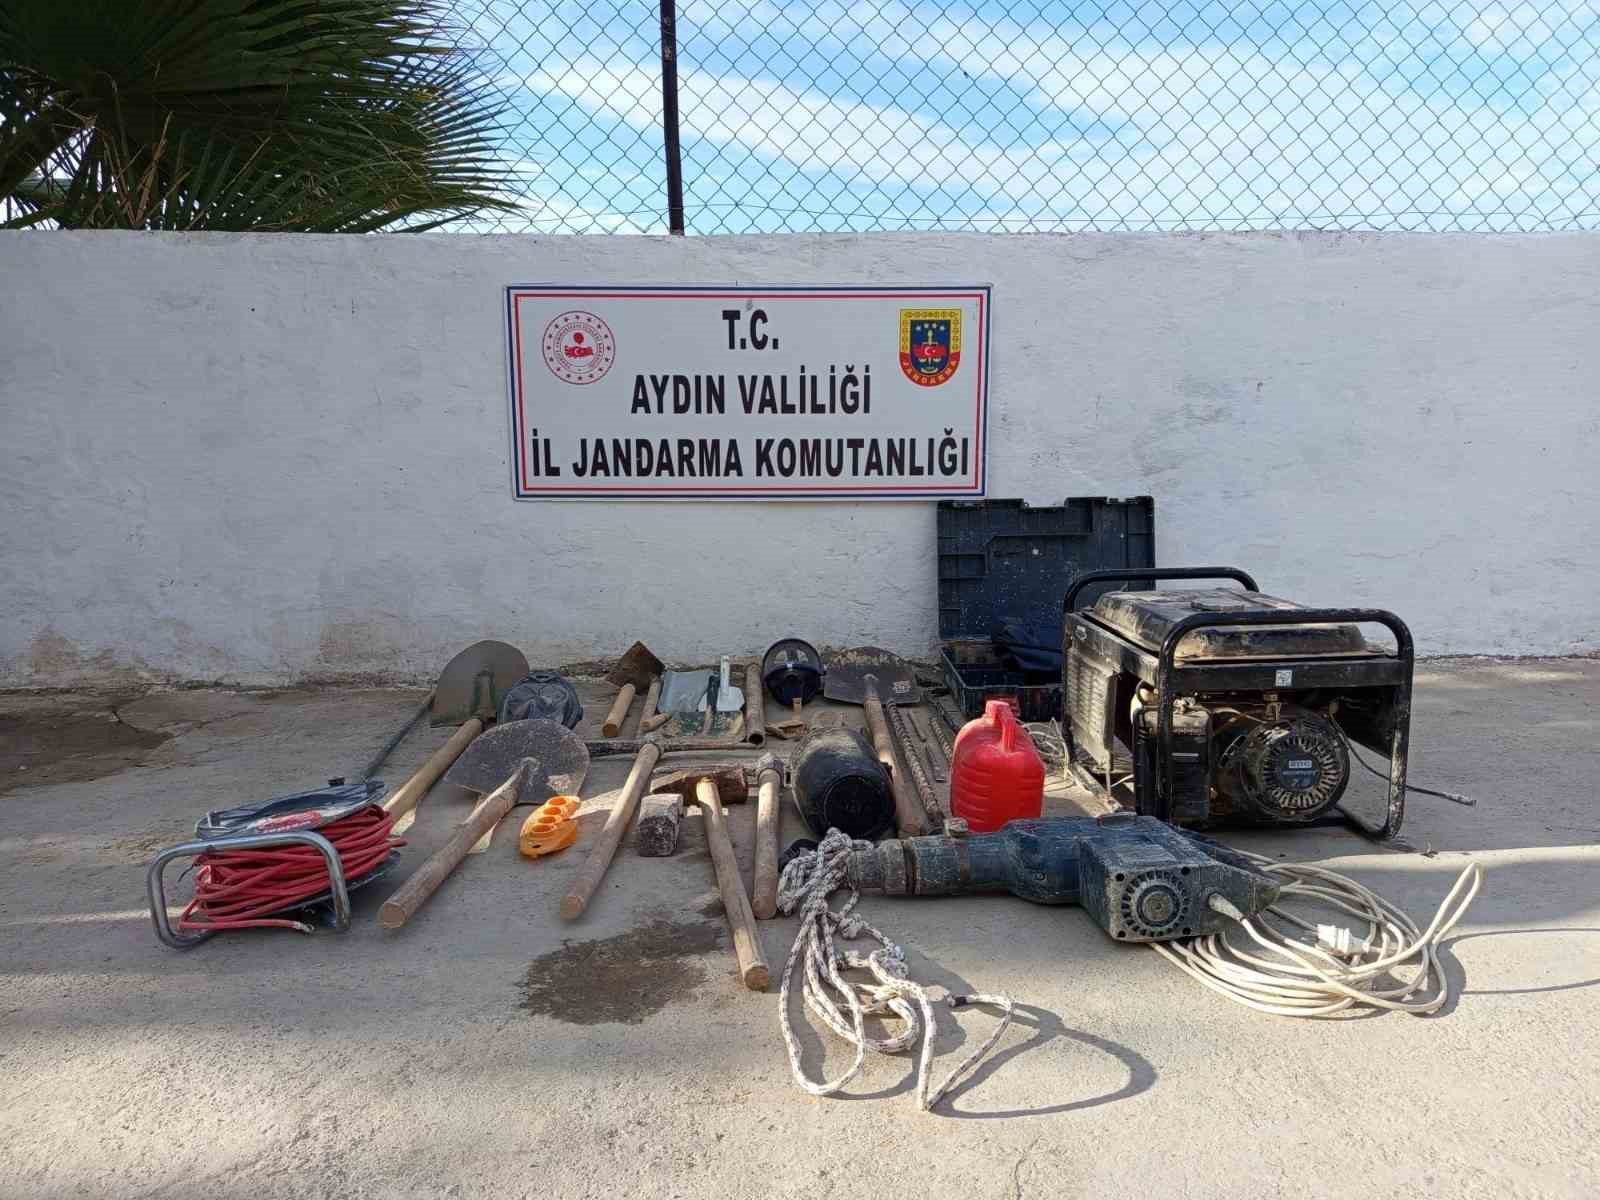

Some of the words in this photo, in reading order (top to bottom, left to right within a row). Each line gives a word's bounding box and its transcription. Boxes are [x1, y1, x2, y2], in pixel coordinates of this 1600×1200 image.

[722, 308, 779, 350] T.C.
[630, 374, 726, 415] AYDIN
[737, 364, 871, 415] VALİLİĞİ
[532, 428, 561, 477] İL
[572, 438, 744, 478] JANDARMA
[755, 428, 969, 478] KOMUTANLIĞI
